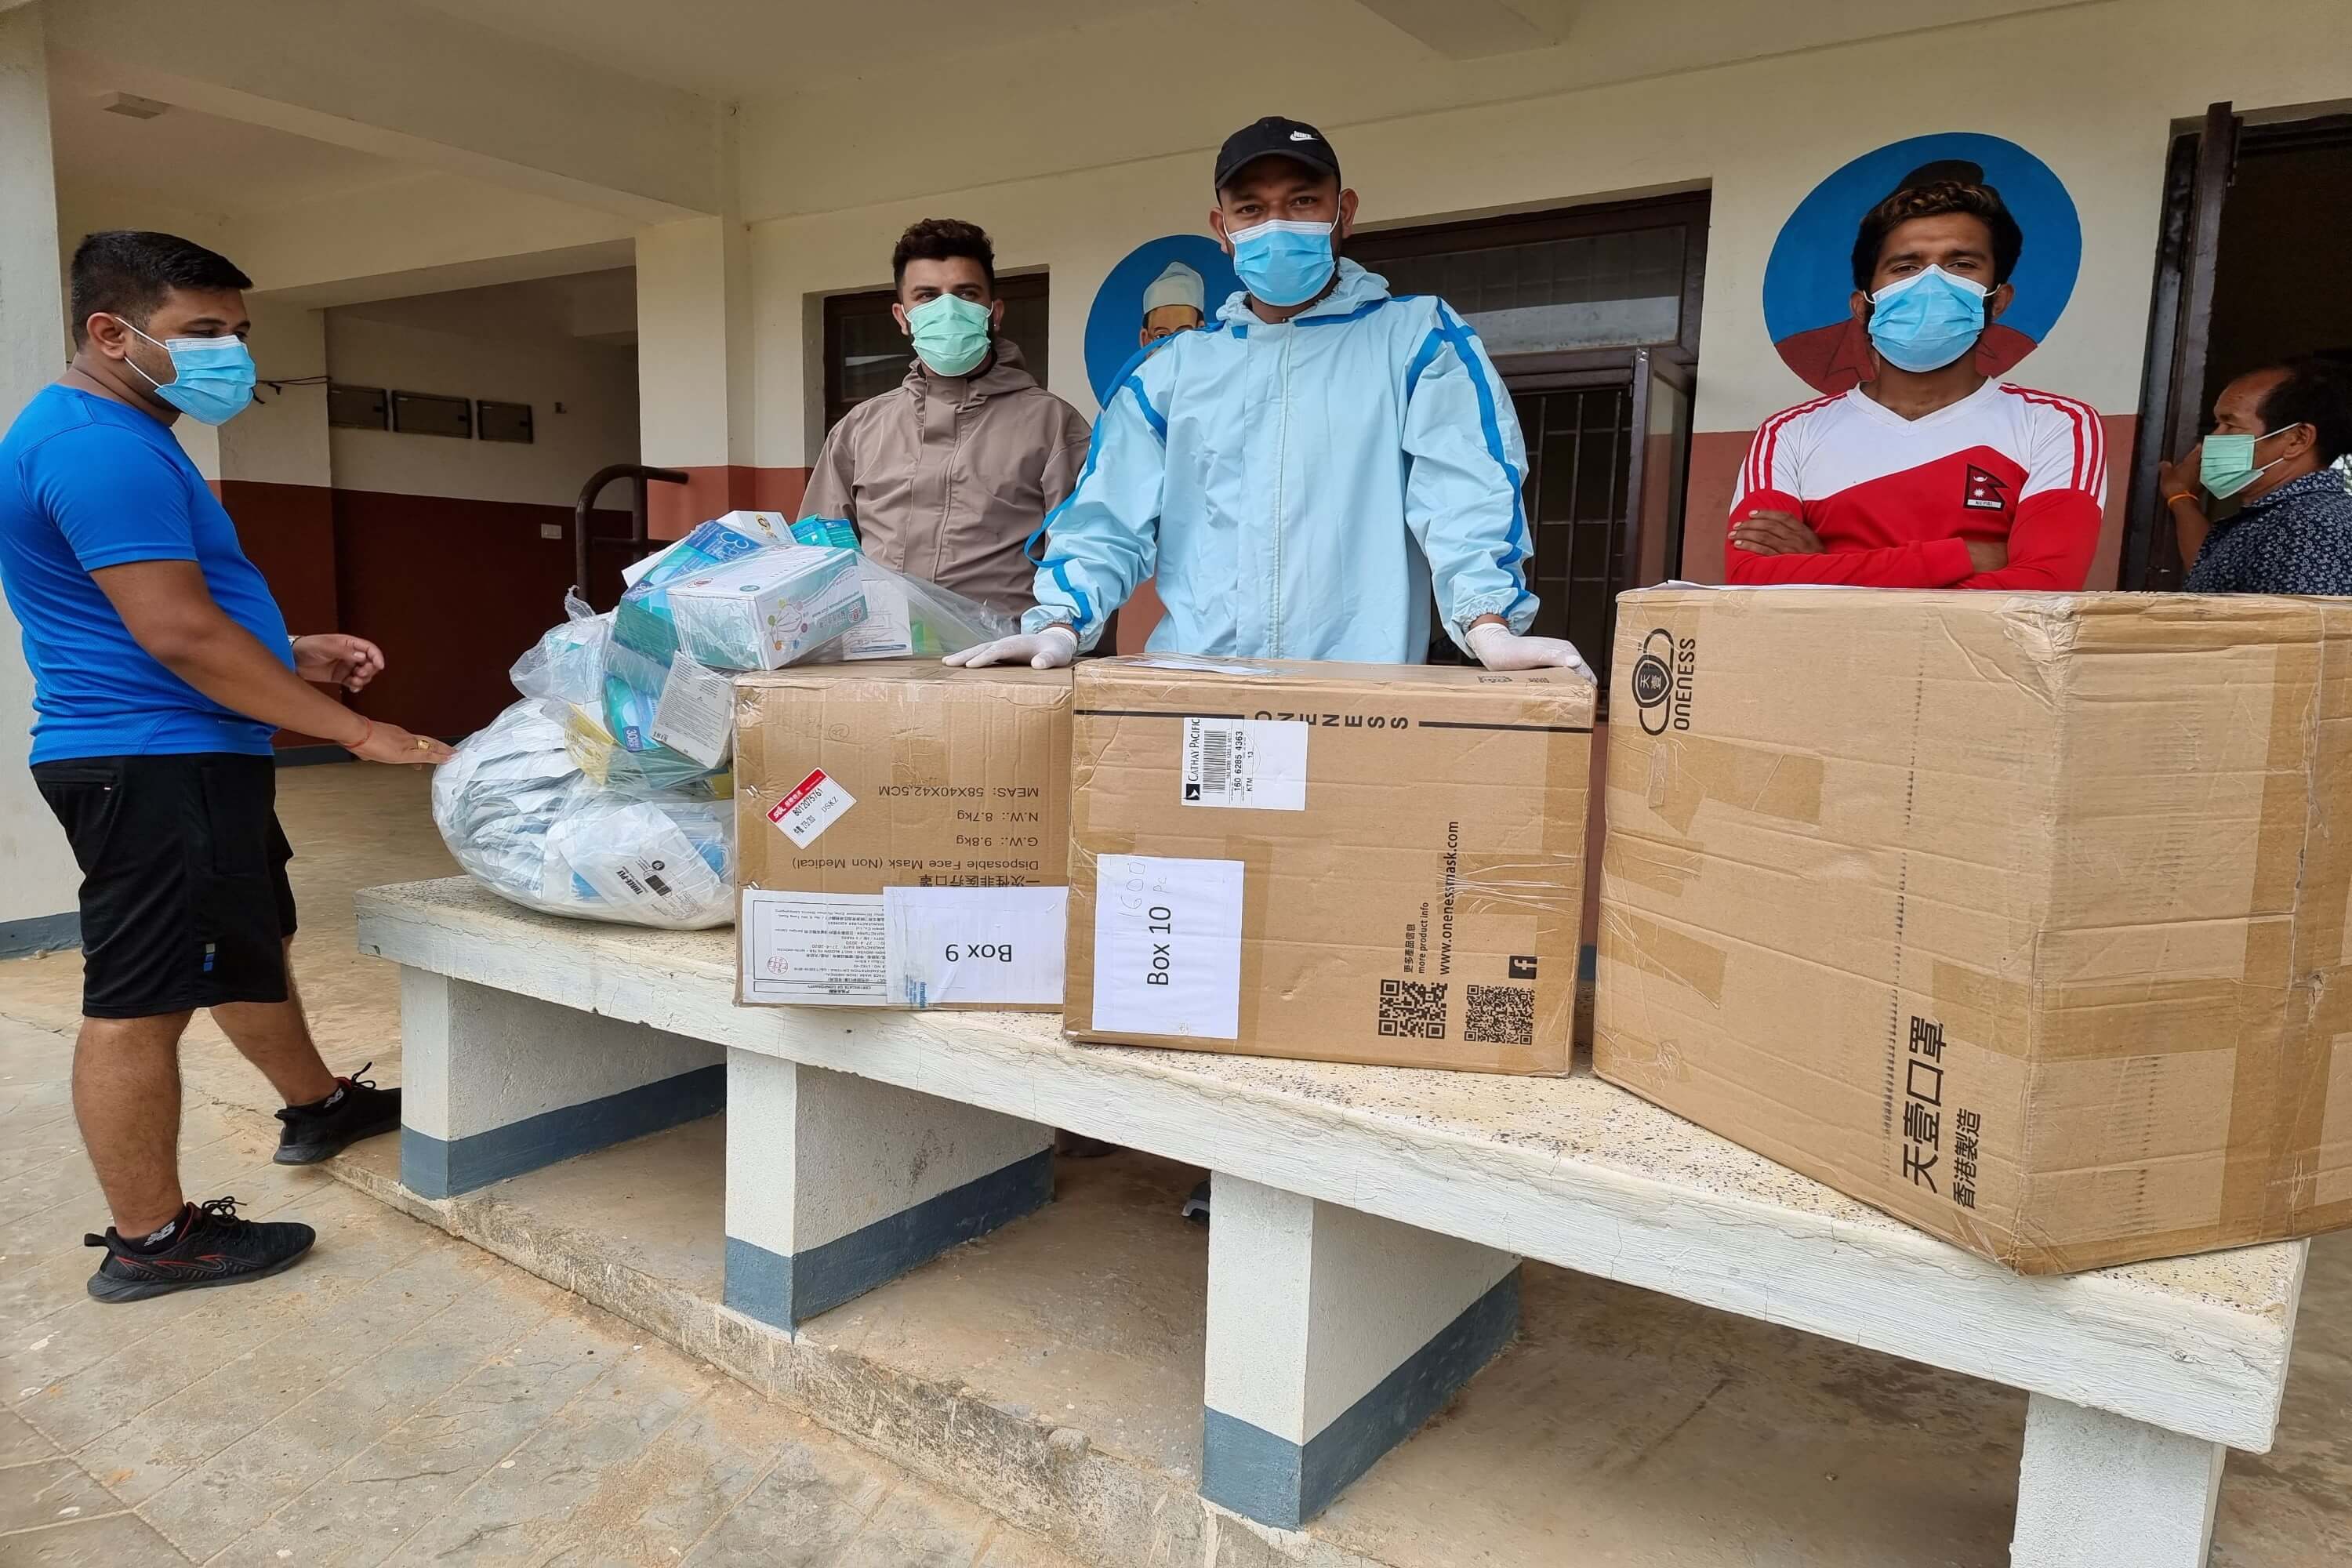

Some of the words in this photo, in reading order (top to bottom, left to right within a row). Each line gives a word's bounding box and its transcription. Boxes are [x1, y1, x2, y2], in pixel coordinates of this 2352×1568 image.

[1673, 637, 1696, 731] ONENESS
[1189, 717, 1200, 748] PACIFIC
[1188, 750, 1200, 782] CATHAY
[993, 787, 1039, 797] MEAS:
[957, 810, 993, 822] 8.7kg
[956, 834, 992, 847] 9.8kg
[792, 857, 846, 869] Medical)
[851, 858, 883, 869] (Non
[889, 858, 923, 869] Mask
[930, 860, 960, 870] Face
[967, 859, 1039, 871] Disposable
[918, 874, 1040, 887] 一次性非医疗口罩
[1439, 821, 1459, 975] www.onenessmask.com
[1420, 902, 1429, 917] info
[1149, 906, 1171, 935] 10
[1419, 917, 1428, 952] product
[946, 943, 960, 962] 9
[967, 943, 1013, 963] Box
[1403, 924, 1416, 973] 更多產品信息
[1146, 943, 1171, 985] Box
[1903, 1015, 1947, 1194] 天壹口罩
[1952, 1107, 1981, 1210] 香港製造
